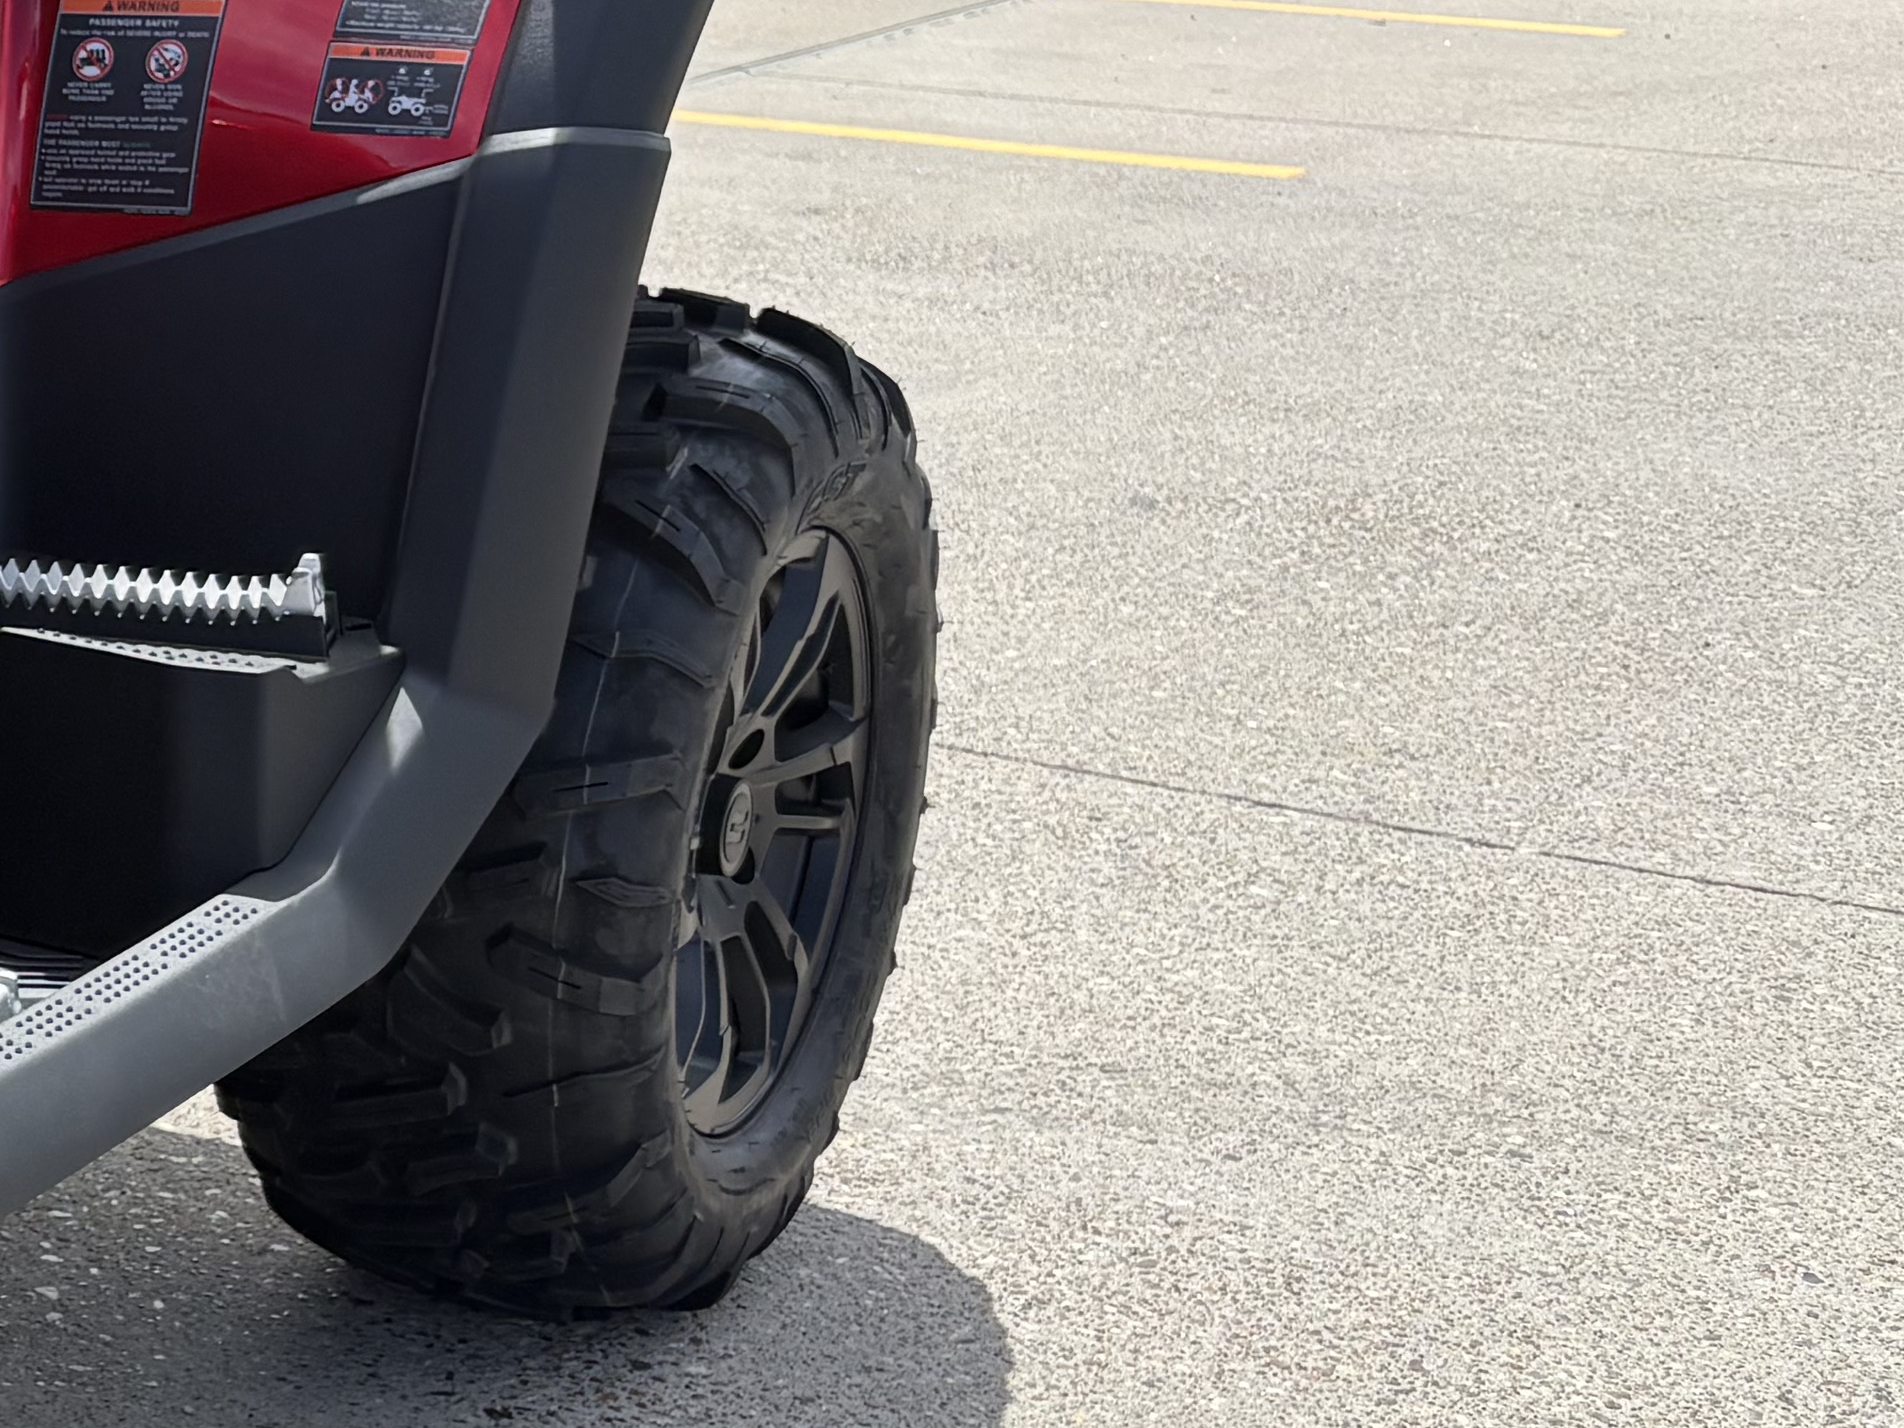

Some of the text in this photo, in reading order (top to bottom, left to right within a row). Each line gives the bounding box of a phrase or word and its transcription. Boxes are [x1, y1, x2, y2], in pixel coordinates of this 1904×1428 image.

[117, 0, 180, 12] WARNING
[89, 18, 180, 28] PASSENGER SAFETY
[375, 48, 436, 60] WARNING
